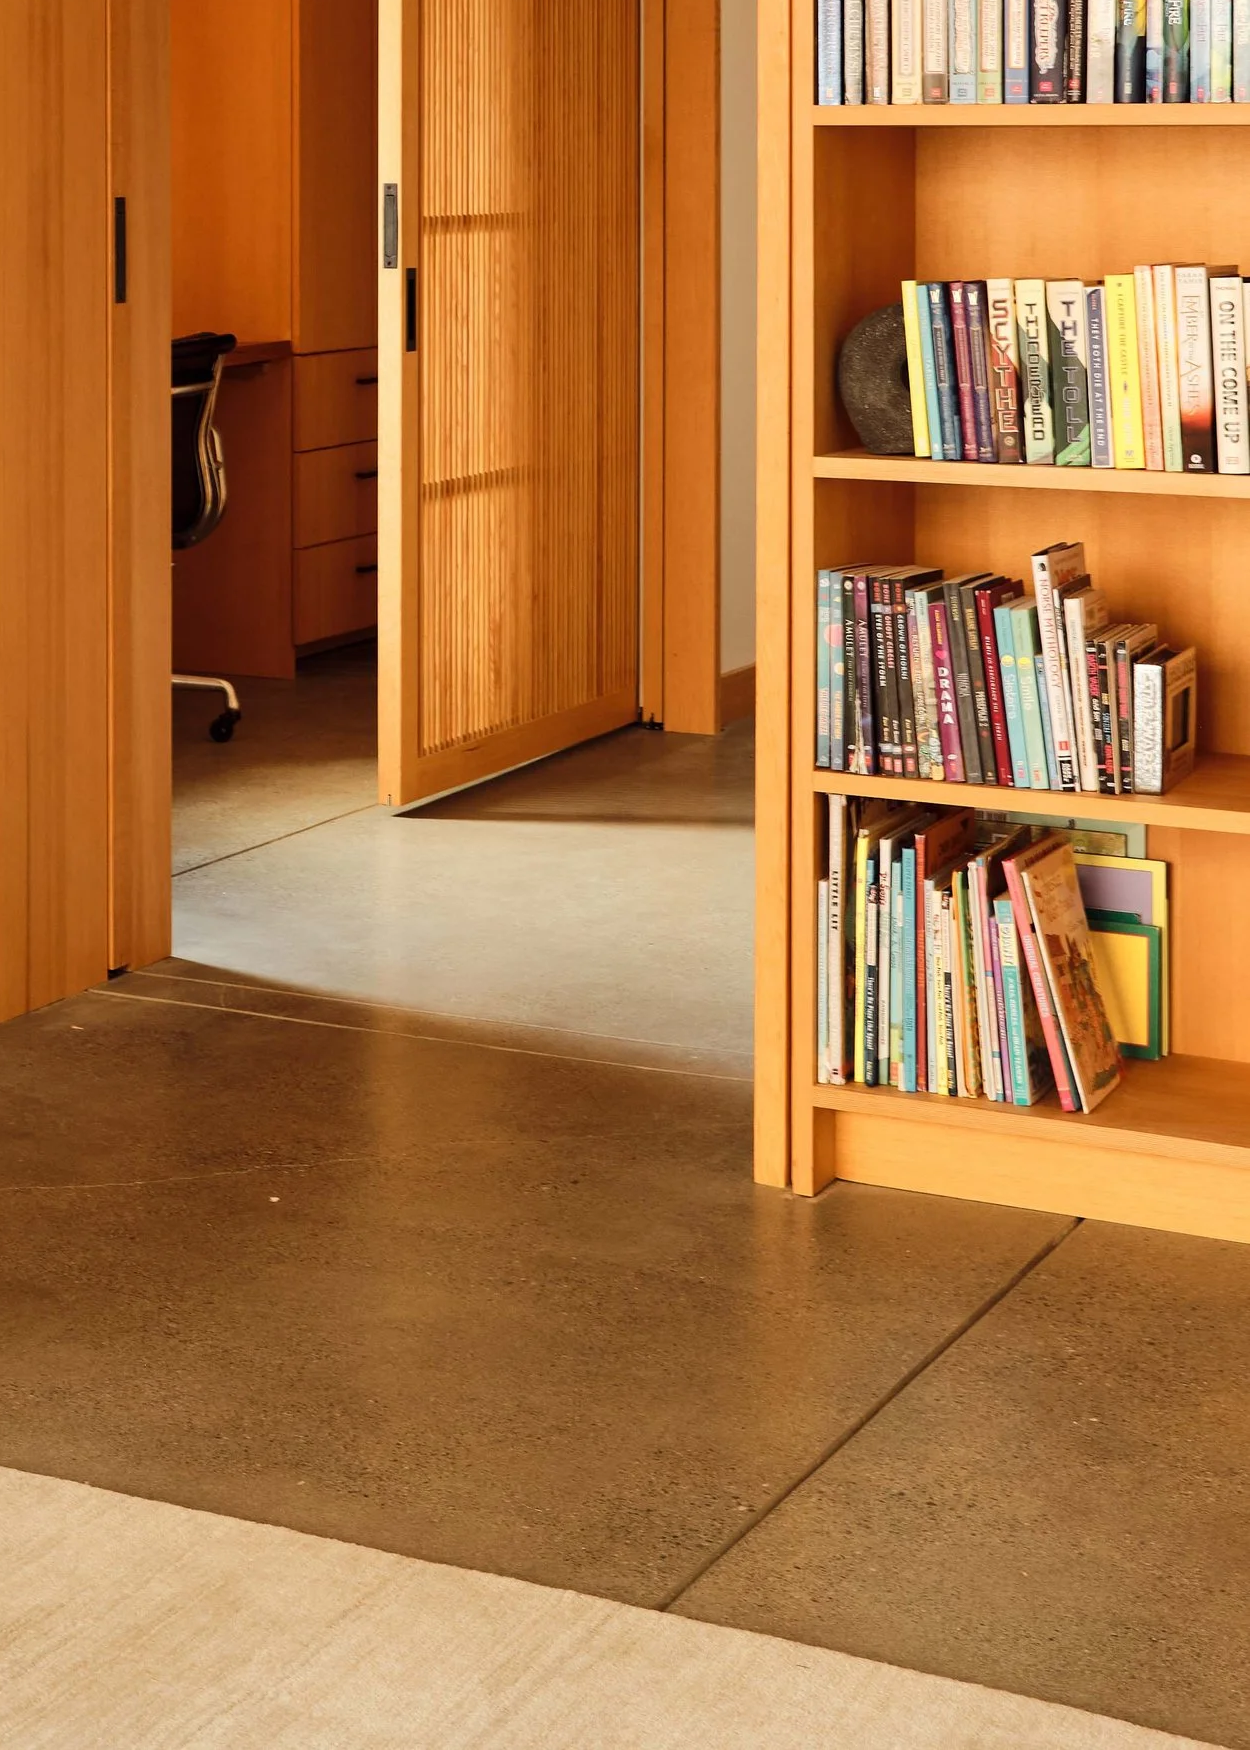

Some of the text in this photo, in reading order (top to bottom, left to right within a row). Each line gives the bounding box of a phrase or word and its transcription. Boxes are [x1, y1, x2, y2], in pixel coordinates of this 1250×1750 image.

[1039, 11, 1051, 61] KEEPERS
[1169, 0, 1182, 25] FIRE
[1060, 300, 1082, 443] THE TOLL
[1090, 318, 1105, 447] THEY BOTH DIE AT THE END
[1218, 300, 1240, 444] ON THE COME UP
[949, 596, 959, 622] STEVENSON
[1038, 578, 1061, 689] NORSE MYTHOLOGY
[845, 619, 853, 657] AMULET
[858, 619, 867, 658] AMULET
[876, 633, 884, 643] OF
[876, 645, 885, 660] THE
[884, 615, 895, 669] GHOST CIRCLES
[896, 614, 908, 680] CROWN OF HORNS
[877, 662, 887, 687] STORM
[937, 667, 955, 725] DRAMA
[975, 691, 986, 722] PERSEPOLIS
[831, 870, 839, 931] LITTLE LIT
[1022, 934, 1050, 1018] UNUSUAL CREATURES
